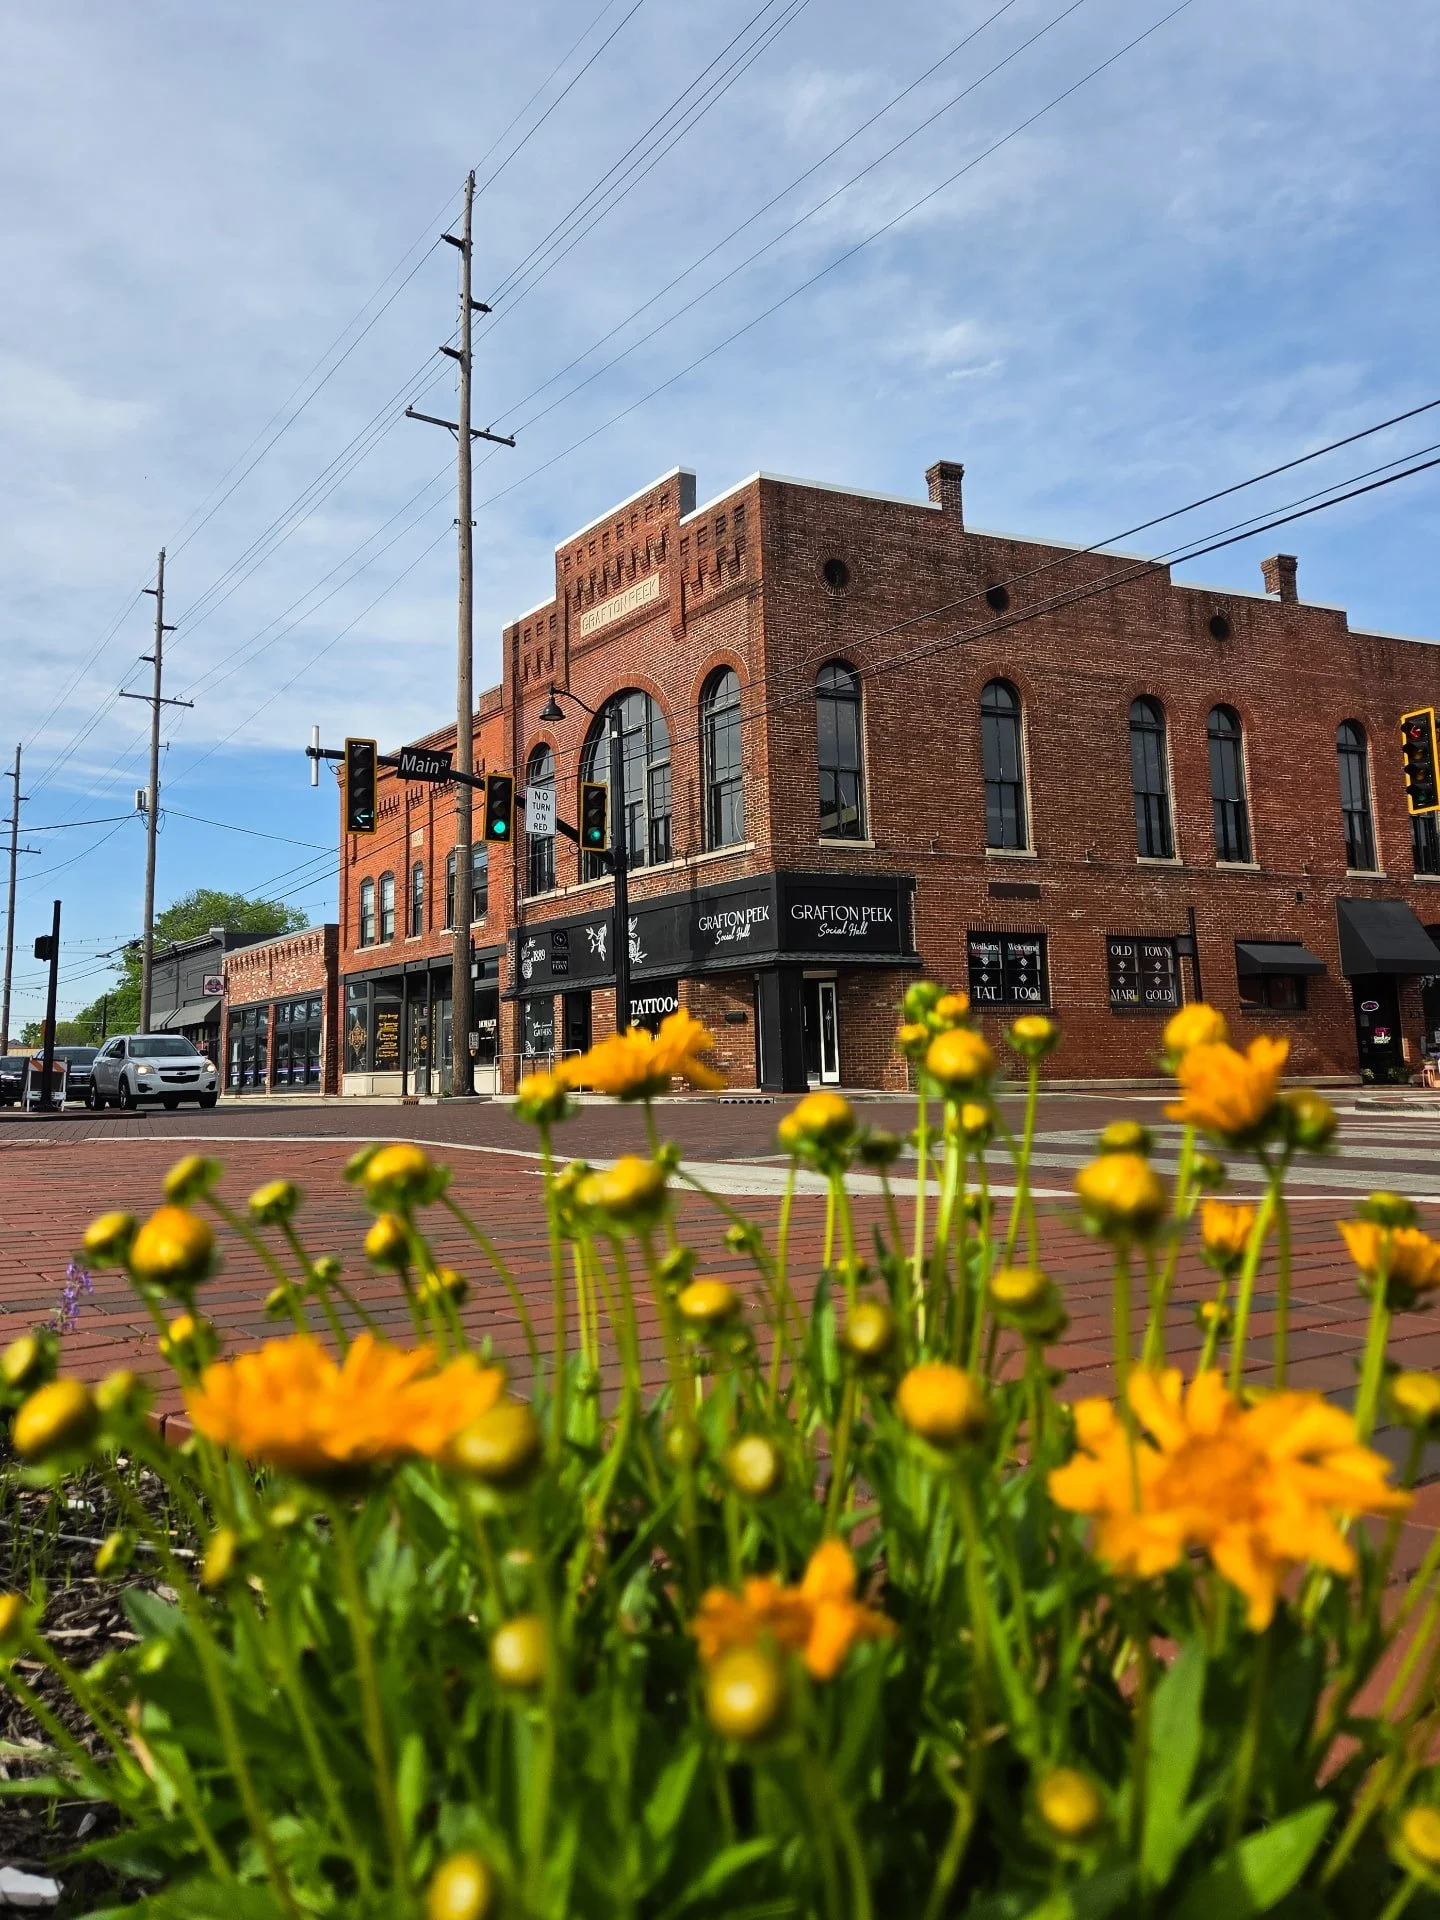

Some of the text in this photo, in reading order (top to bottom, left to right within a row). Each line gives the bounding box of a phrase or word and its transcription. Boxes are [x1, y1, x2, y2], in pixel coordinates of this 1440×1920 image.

[583, 578, 657, 631] GRAFTON PEEK
[401, 754, 440, 774] Main
[534, 791, 549, 801] NO
[532, 802, 551, 812] TURN
[535, 812, 547, 821] ON
[533, 822, 548, 831] RED
[698, 905, 770, 931] GRAFTON PEEK
[791, 904, 893, 922] GRAFTON PEEK
[715, 923, 751, 945] Social Hall
[817, 920, 869, 937] Social Hall
[1007, 942, 1039, 951] Welcome
[1110, 945, 1172, 957] OLD TOWN
[973, 986, 1038, 999] TAT TOO
[1110, 988, 1172, 1000] MARI GOLD
[630, 996, 673, 1015] TATTOO
